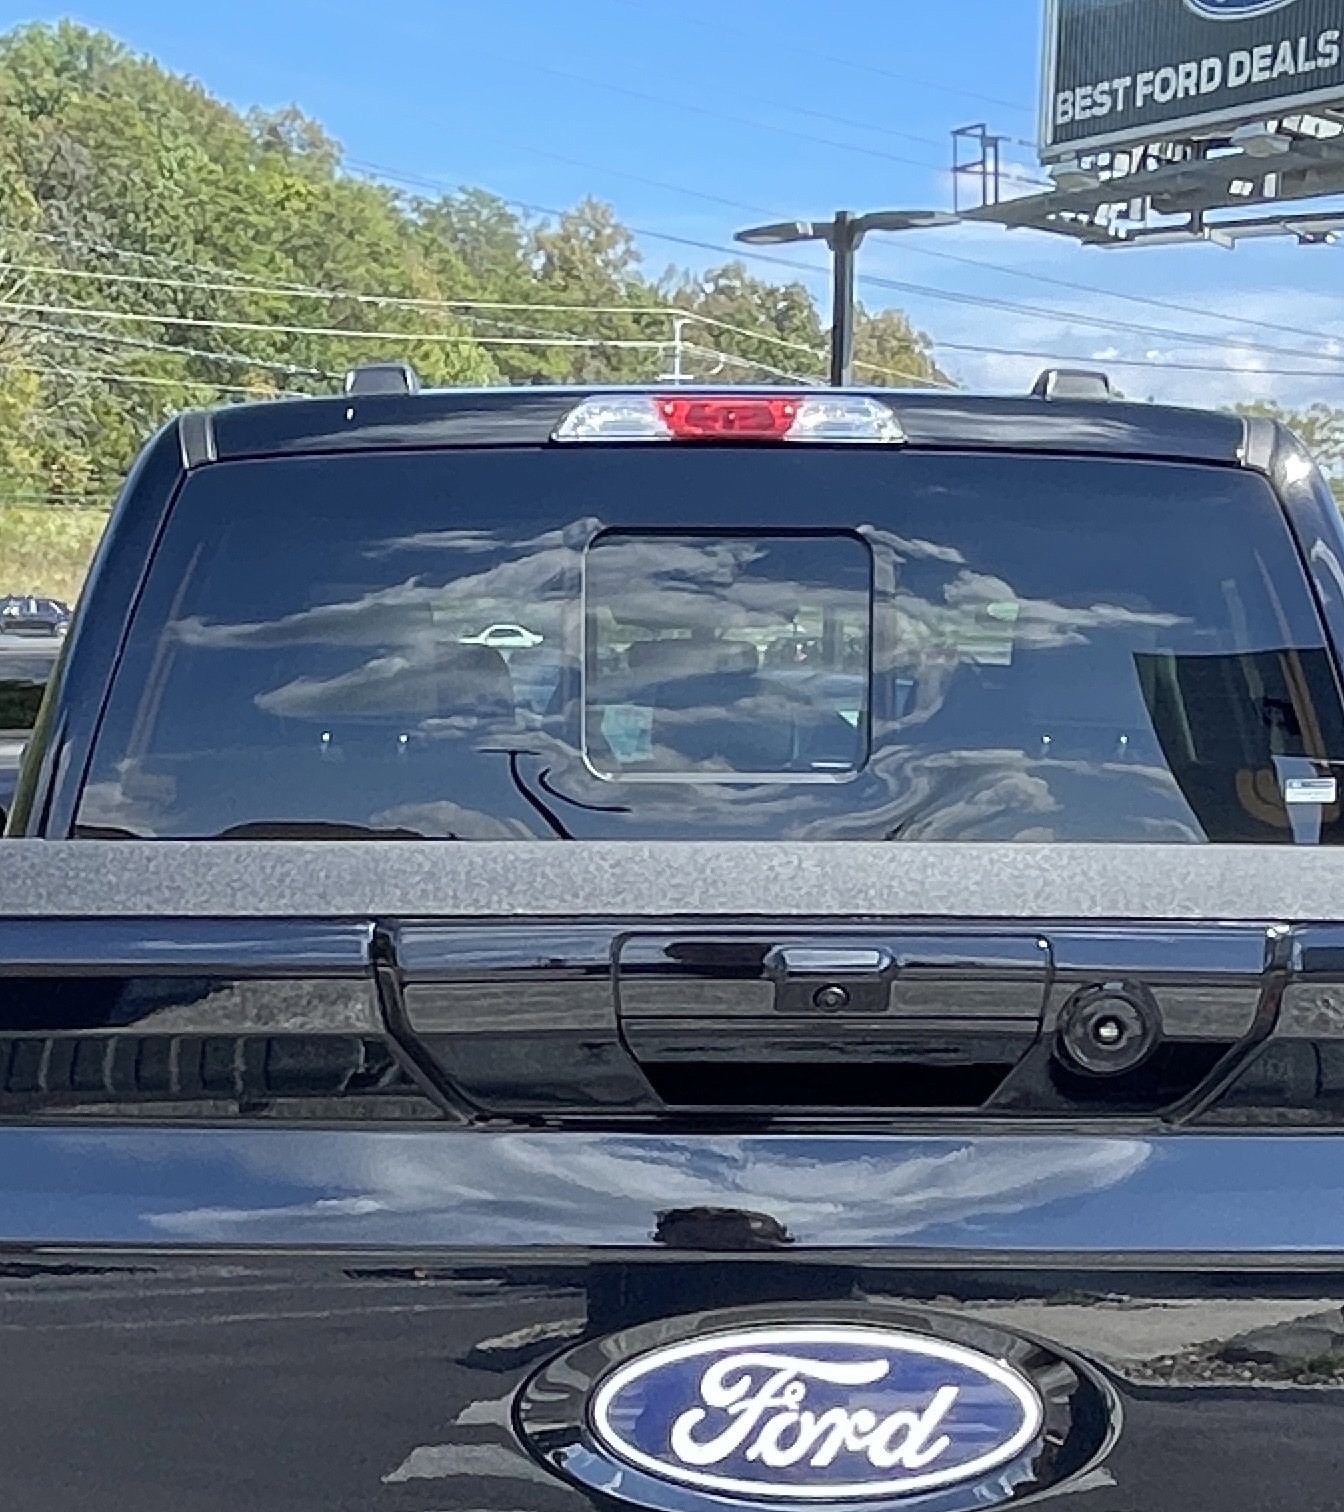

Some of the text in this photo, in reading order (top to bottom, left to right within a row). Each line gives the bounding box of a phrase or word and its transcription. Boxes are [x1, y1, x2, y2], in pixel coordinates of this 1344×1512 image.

[1056, 76, 1131, 125] BEST
[1135, 57, 1222, 108] FORD
[1227, 29, 1340, 88] DEALS
[670, 1350, 960, 1468] Ford
